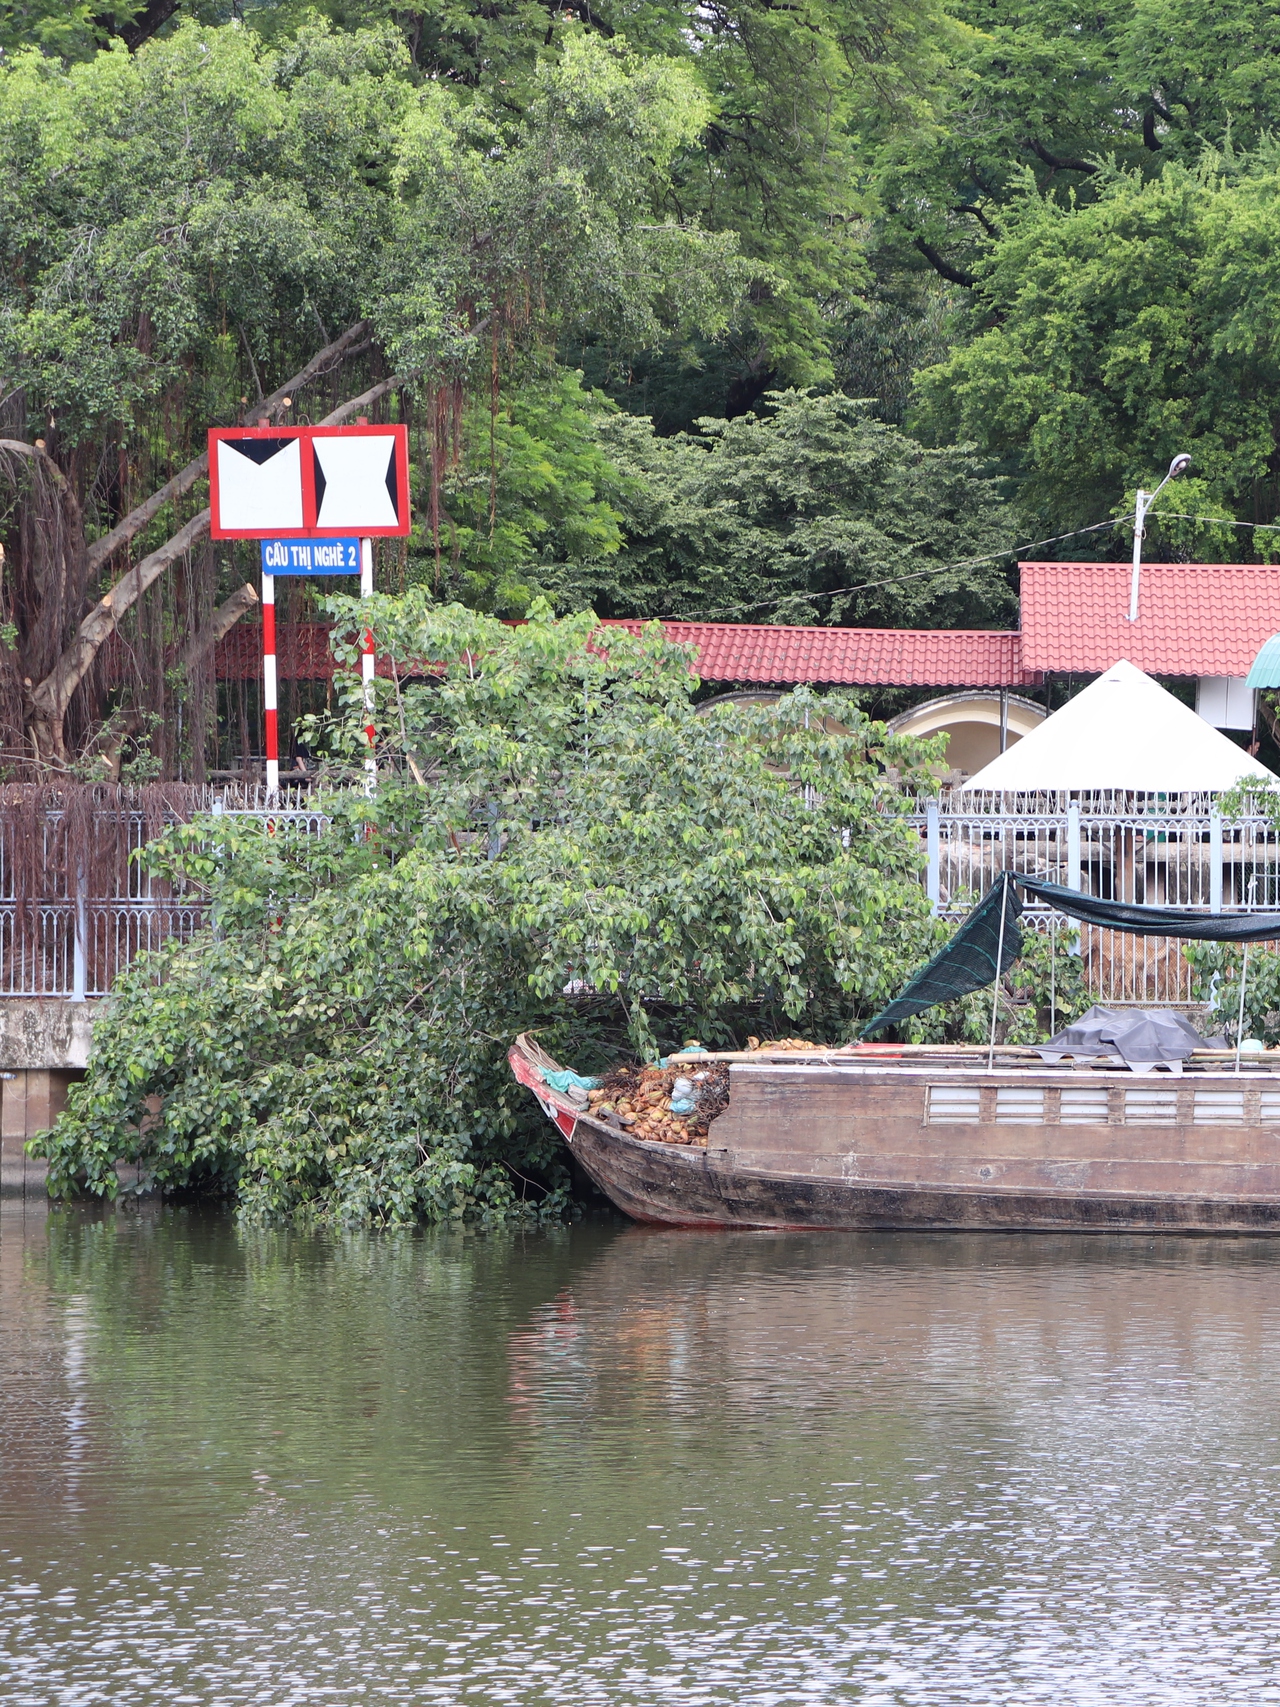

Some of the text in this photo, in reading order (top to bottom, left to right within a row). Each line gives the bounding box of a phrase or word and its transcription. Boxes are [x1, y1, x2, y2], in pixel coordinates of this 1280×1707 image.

[265, 541, 357, 570] CẦU THỊ NGHÈ 2
